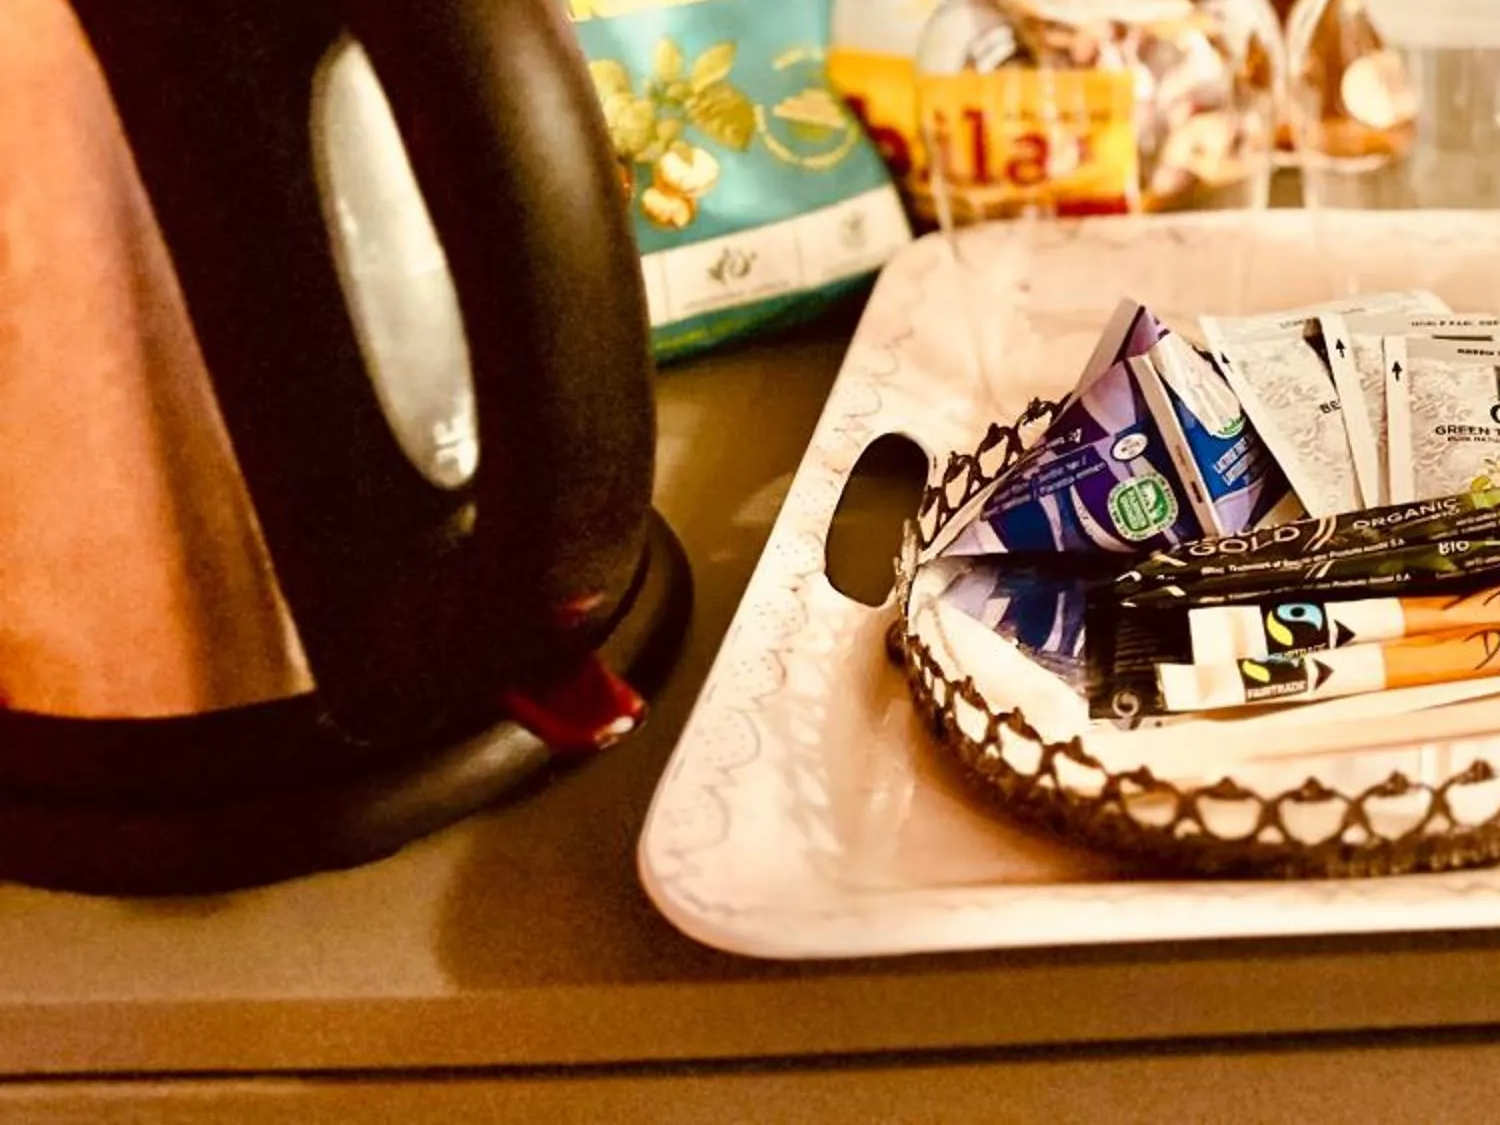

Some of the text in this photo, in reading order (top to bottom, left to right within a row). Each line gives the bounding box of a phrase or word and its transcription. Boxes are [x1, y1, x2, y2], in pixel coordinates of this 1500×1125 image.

[1435, 425, 1490, 437] GREEN
[1352, 497, 1460, 530] ORGANIC
[1189, 526, 1301, 556] GOLD
[1247, 680, 1308, 700] FAIRTRADE
